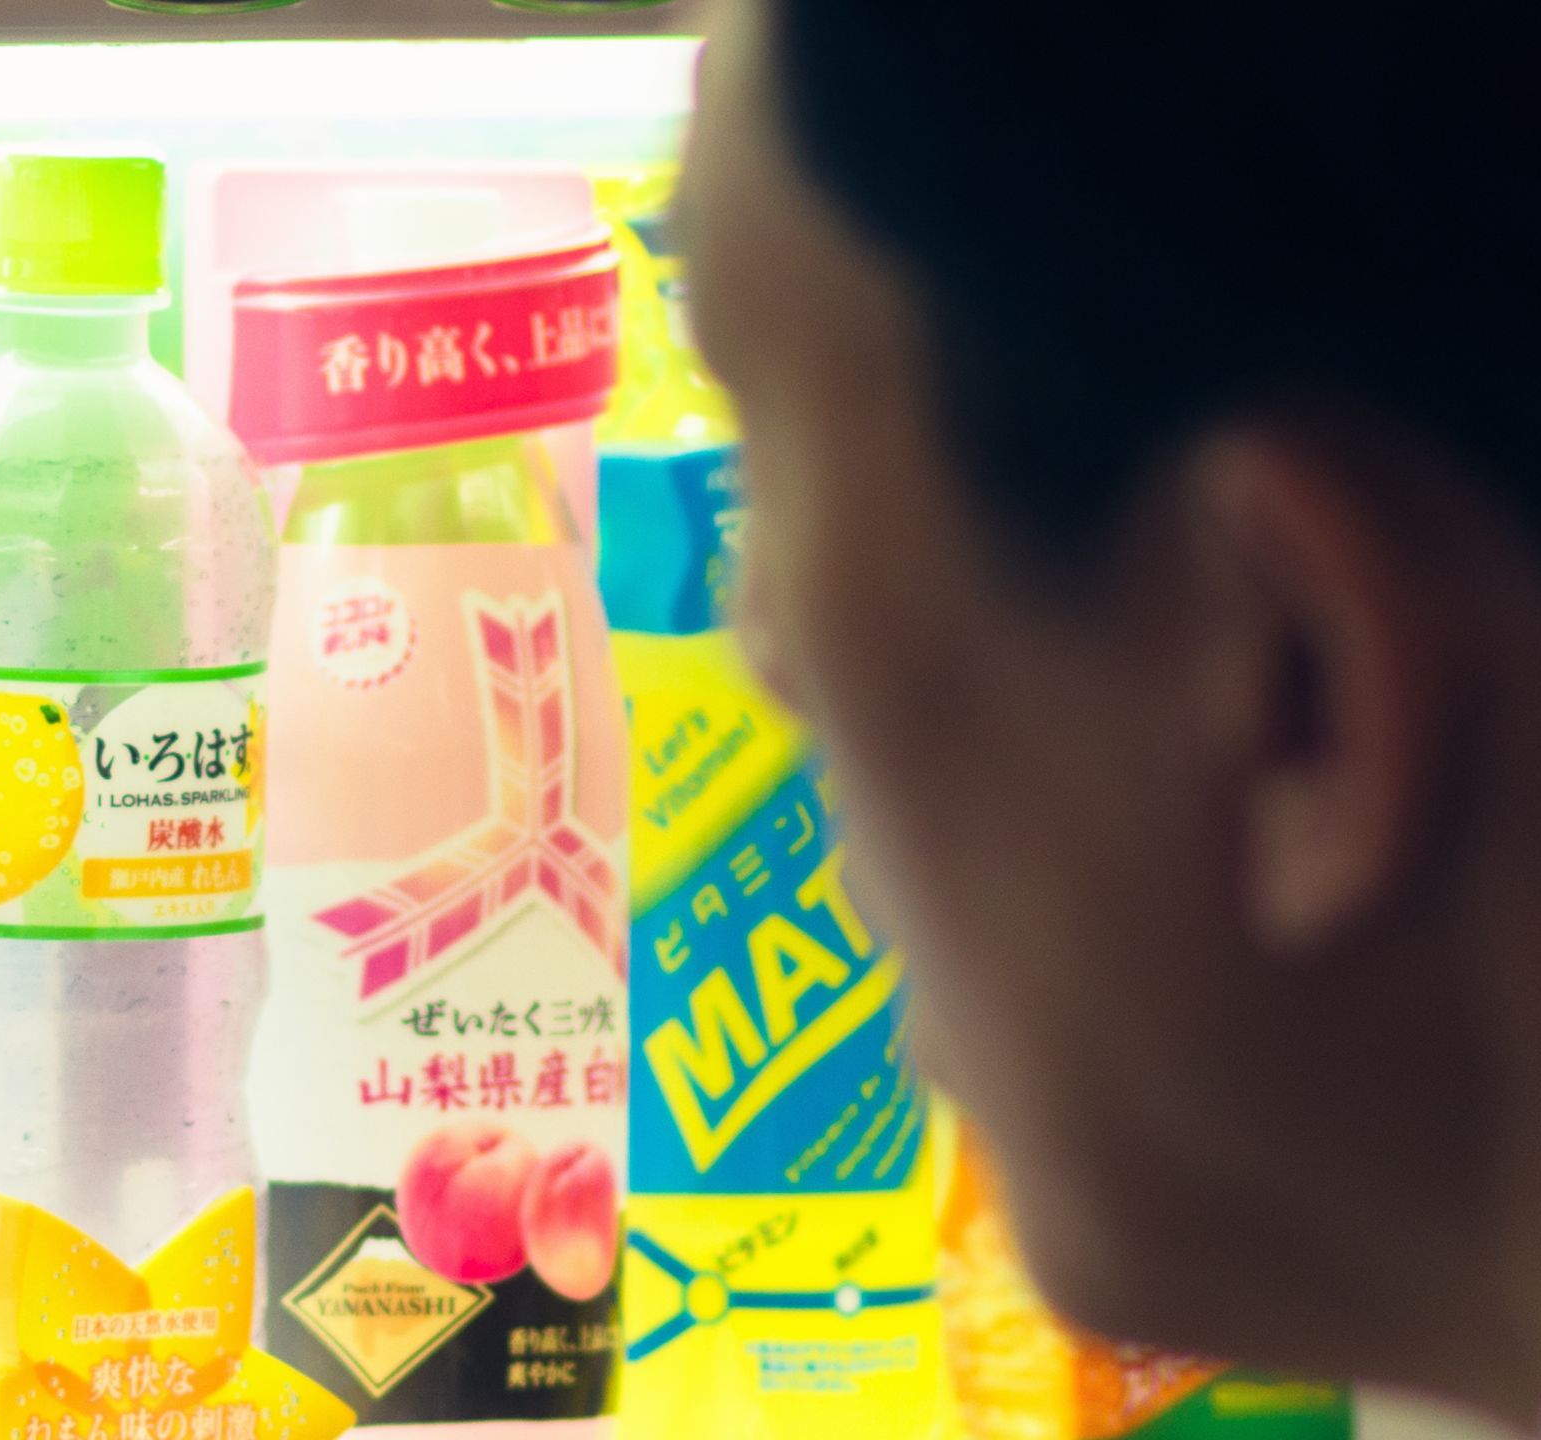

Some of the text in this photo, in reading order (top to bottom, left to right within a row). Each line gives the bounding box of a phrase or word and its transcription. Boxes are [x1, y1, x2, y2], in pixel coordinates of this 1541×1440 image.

[146, 815, 225, 852] 炭酸水
[90, 1357, 197, 1402] 爽快な
